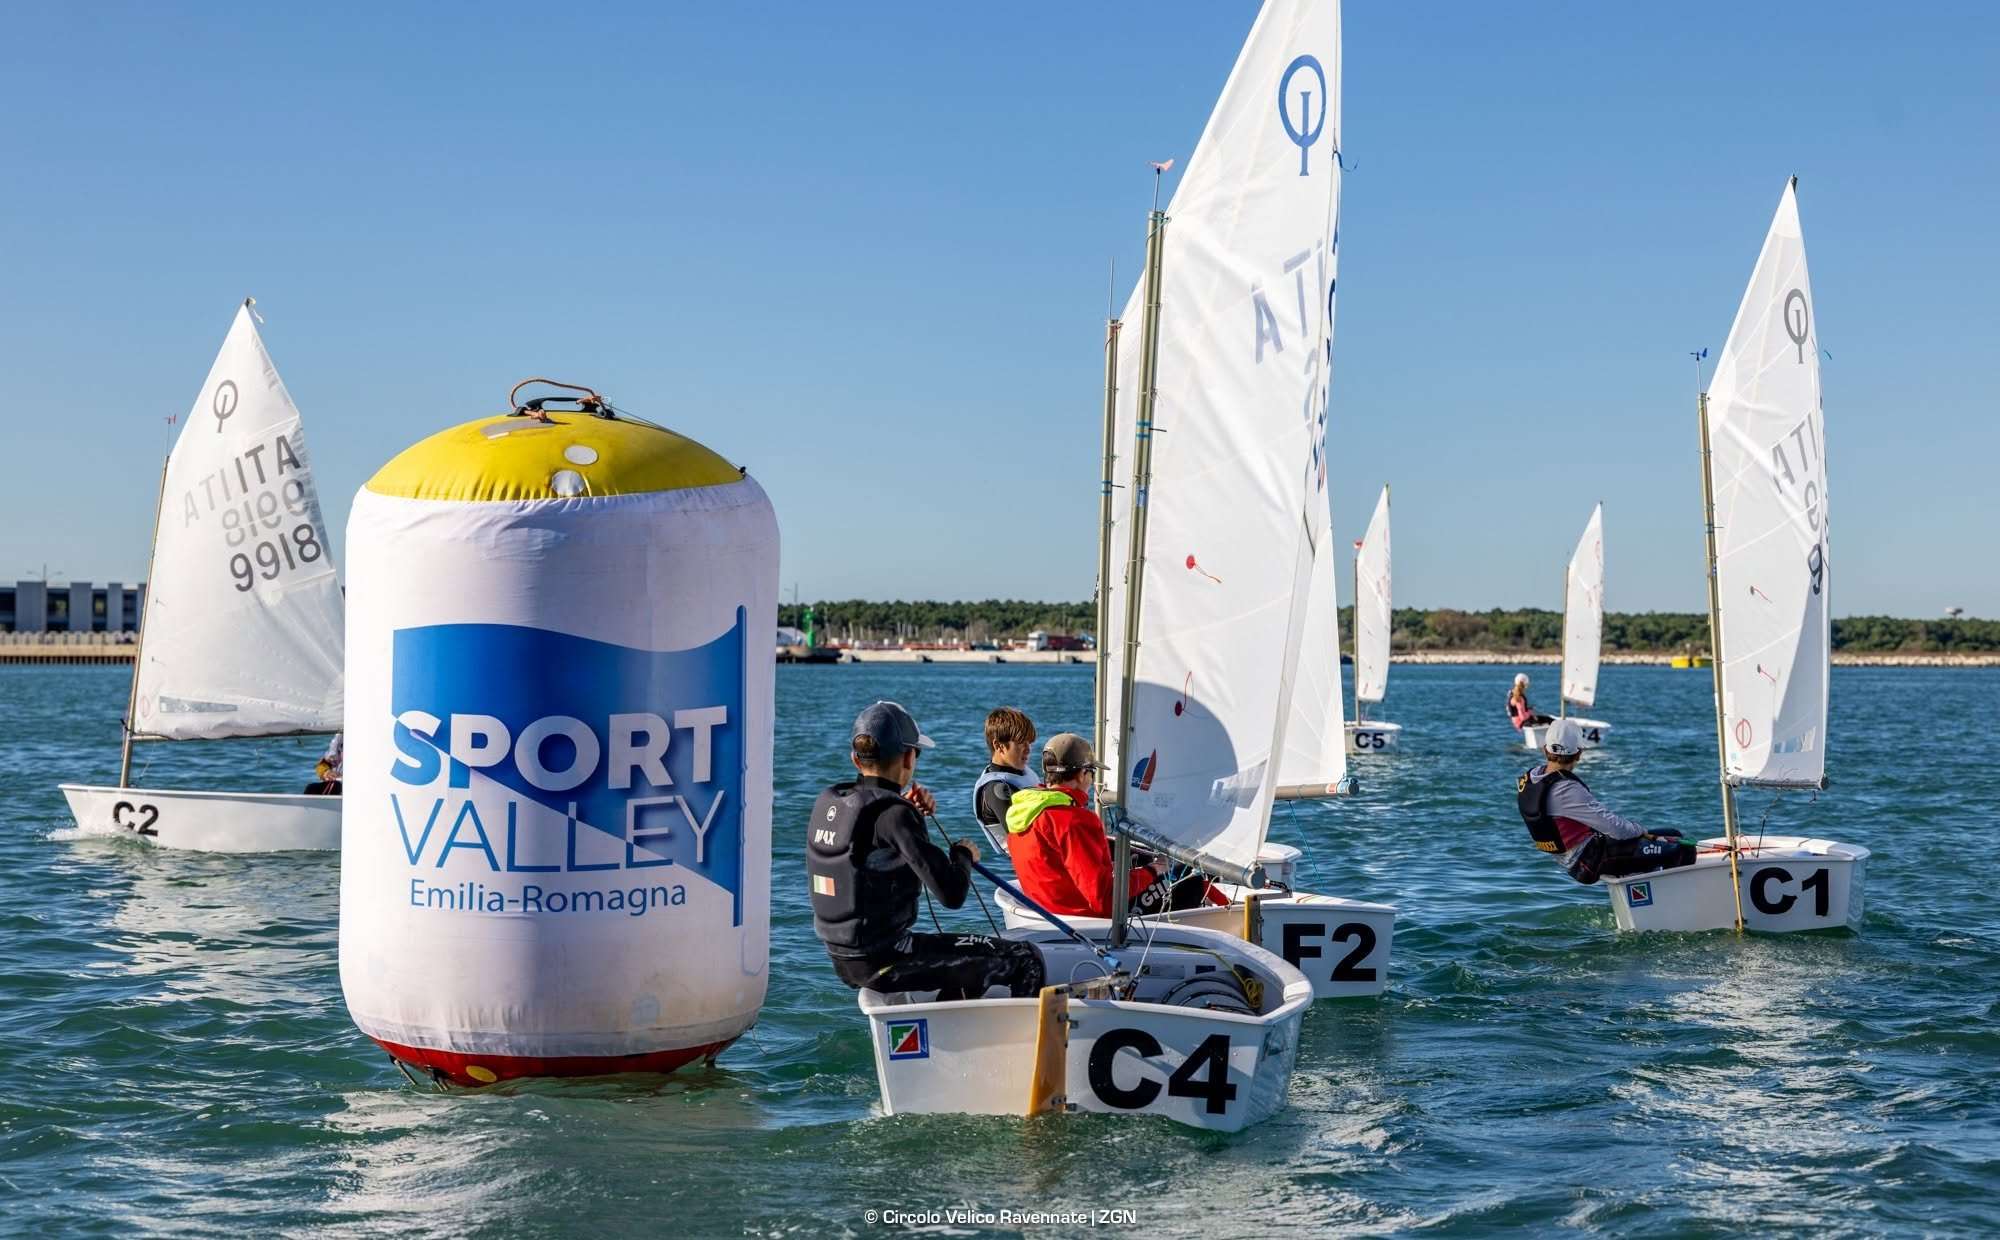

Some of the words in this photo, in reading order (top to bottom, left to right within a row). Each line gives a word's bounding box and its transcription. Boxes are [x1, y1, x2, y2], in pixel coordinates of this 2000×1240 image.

[234, 435, 300, 494] ITA
[230, 523, 321, 592] 9918
[390, 705, 727, 792] SPORT
[1355, 732, 1385, 749] C5
[113, 801, 159, 837] C2
[390, 789, 725, 873] VALLEY
[1643, 844, 1662, 855] Gill
[410, 878, 687, 916] Emilia-Romagna
[1750, 867, 1829, 917] C1
[954, 934, 996, 949] Zhik
[1283, 922, 1377, 982] F2
[1088, 1028, 1237, 1115] C4
